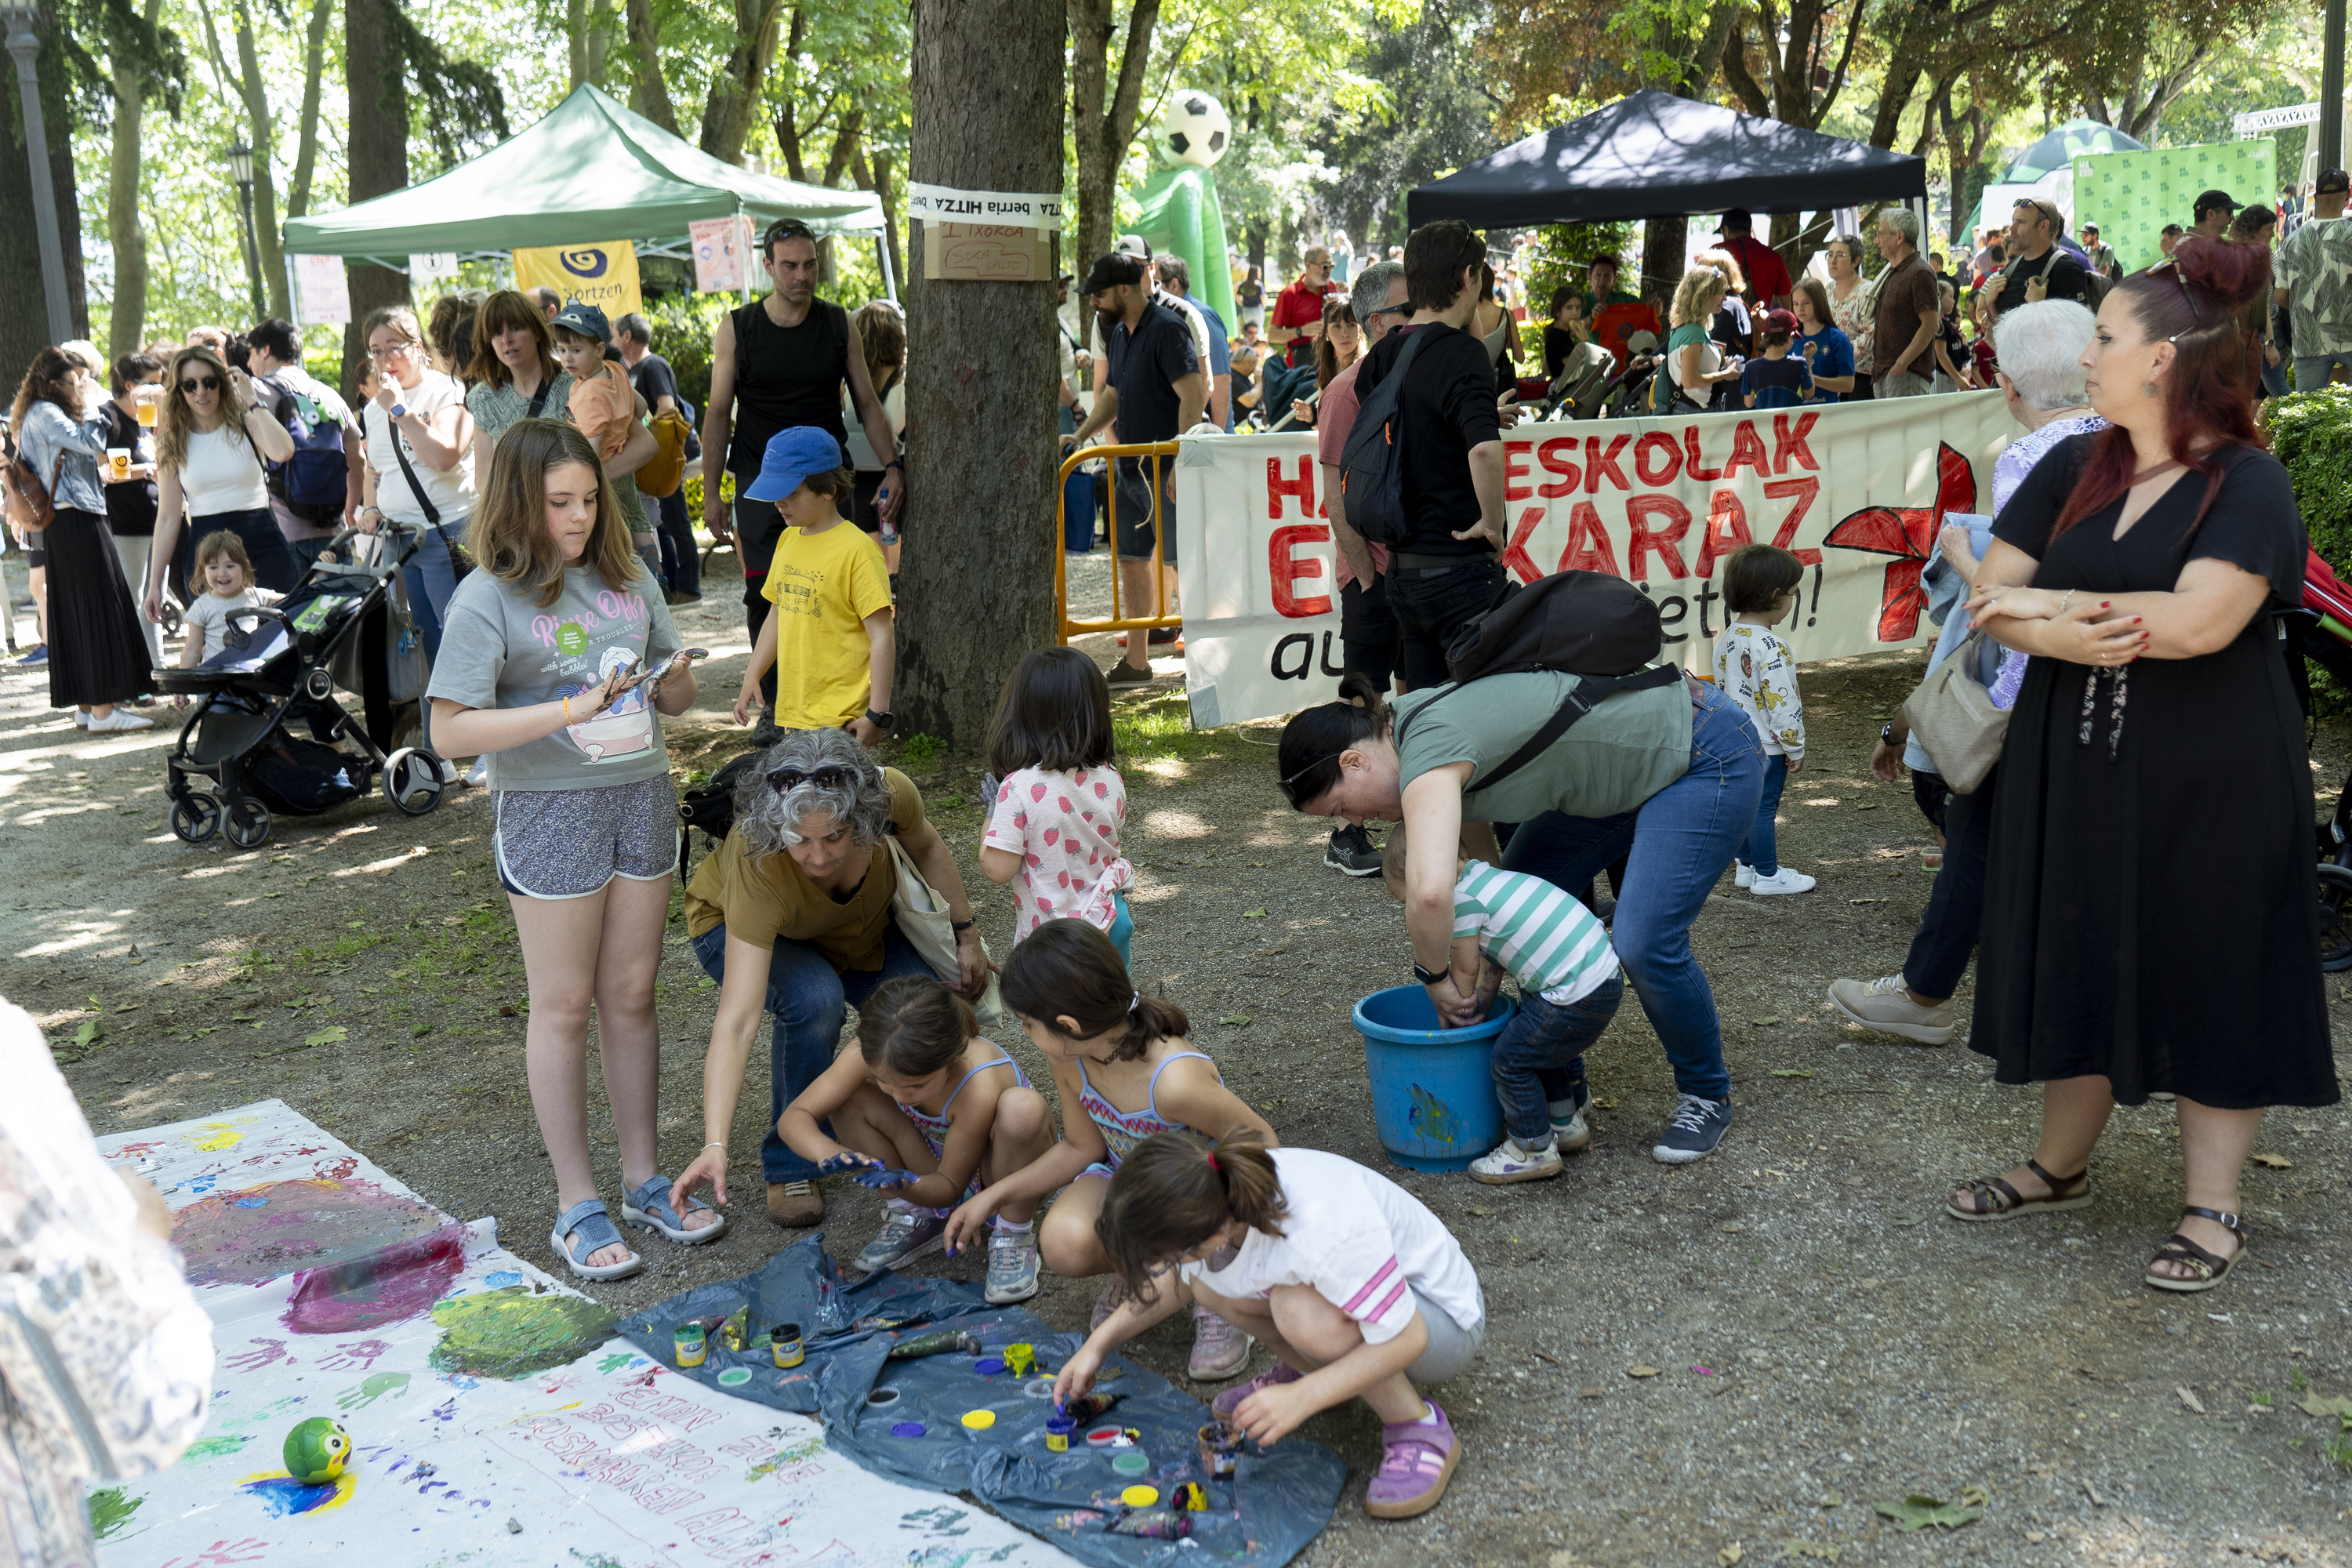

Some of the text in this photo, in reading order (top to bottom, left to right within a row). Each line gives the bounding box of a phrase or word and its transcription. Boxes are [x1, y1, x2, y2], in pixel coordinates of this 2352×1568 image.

[935, 198, 982, 214] HITZA
[988, 202, 1029, 216] berria
[953, 250, 989, 265] SOKA
[985, 260, 1021, 270] SALTO
[563, 283, 622, 300] Sortzen
[1504, 412, 1821, 502] ESKOLAK
[596, 624, 633, 644] TROUBLES
[1766, 635, 1777, 648] LION
[1762, 637, 1772, 650] KING
[541, 657, 578, 673] with some
[560, 660, 589, 677] bubbles!
[1739, 688, 1752, 698] KING
[1740, 684, 1752, 693] LION
[615, 1389, 722, 1433] EMAN
